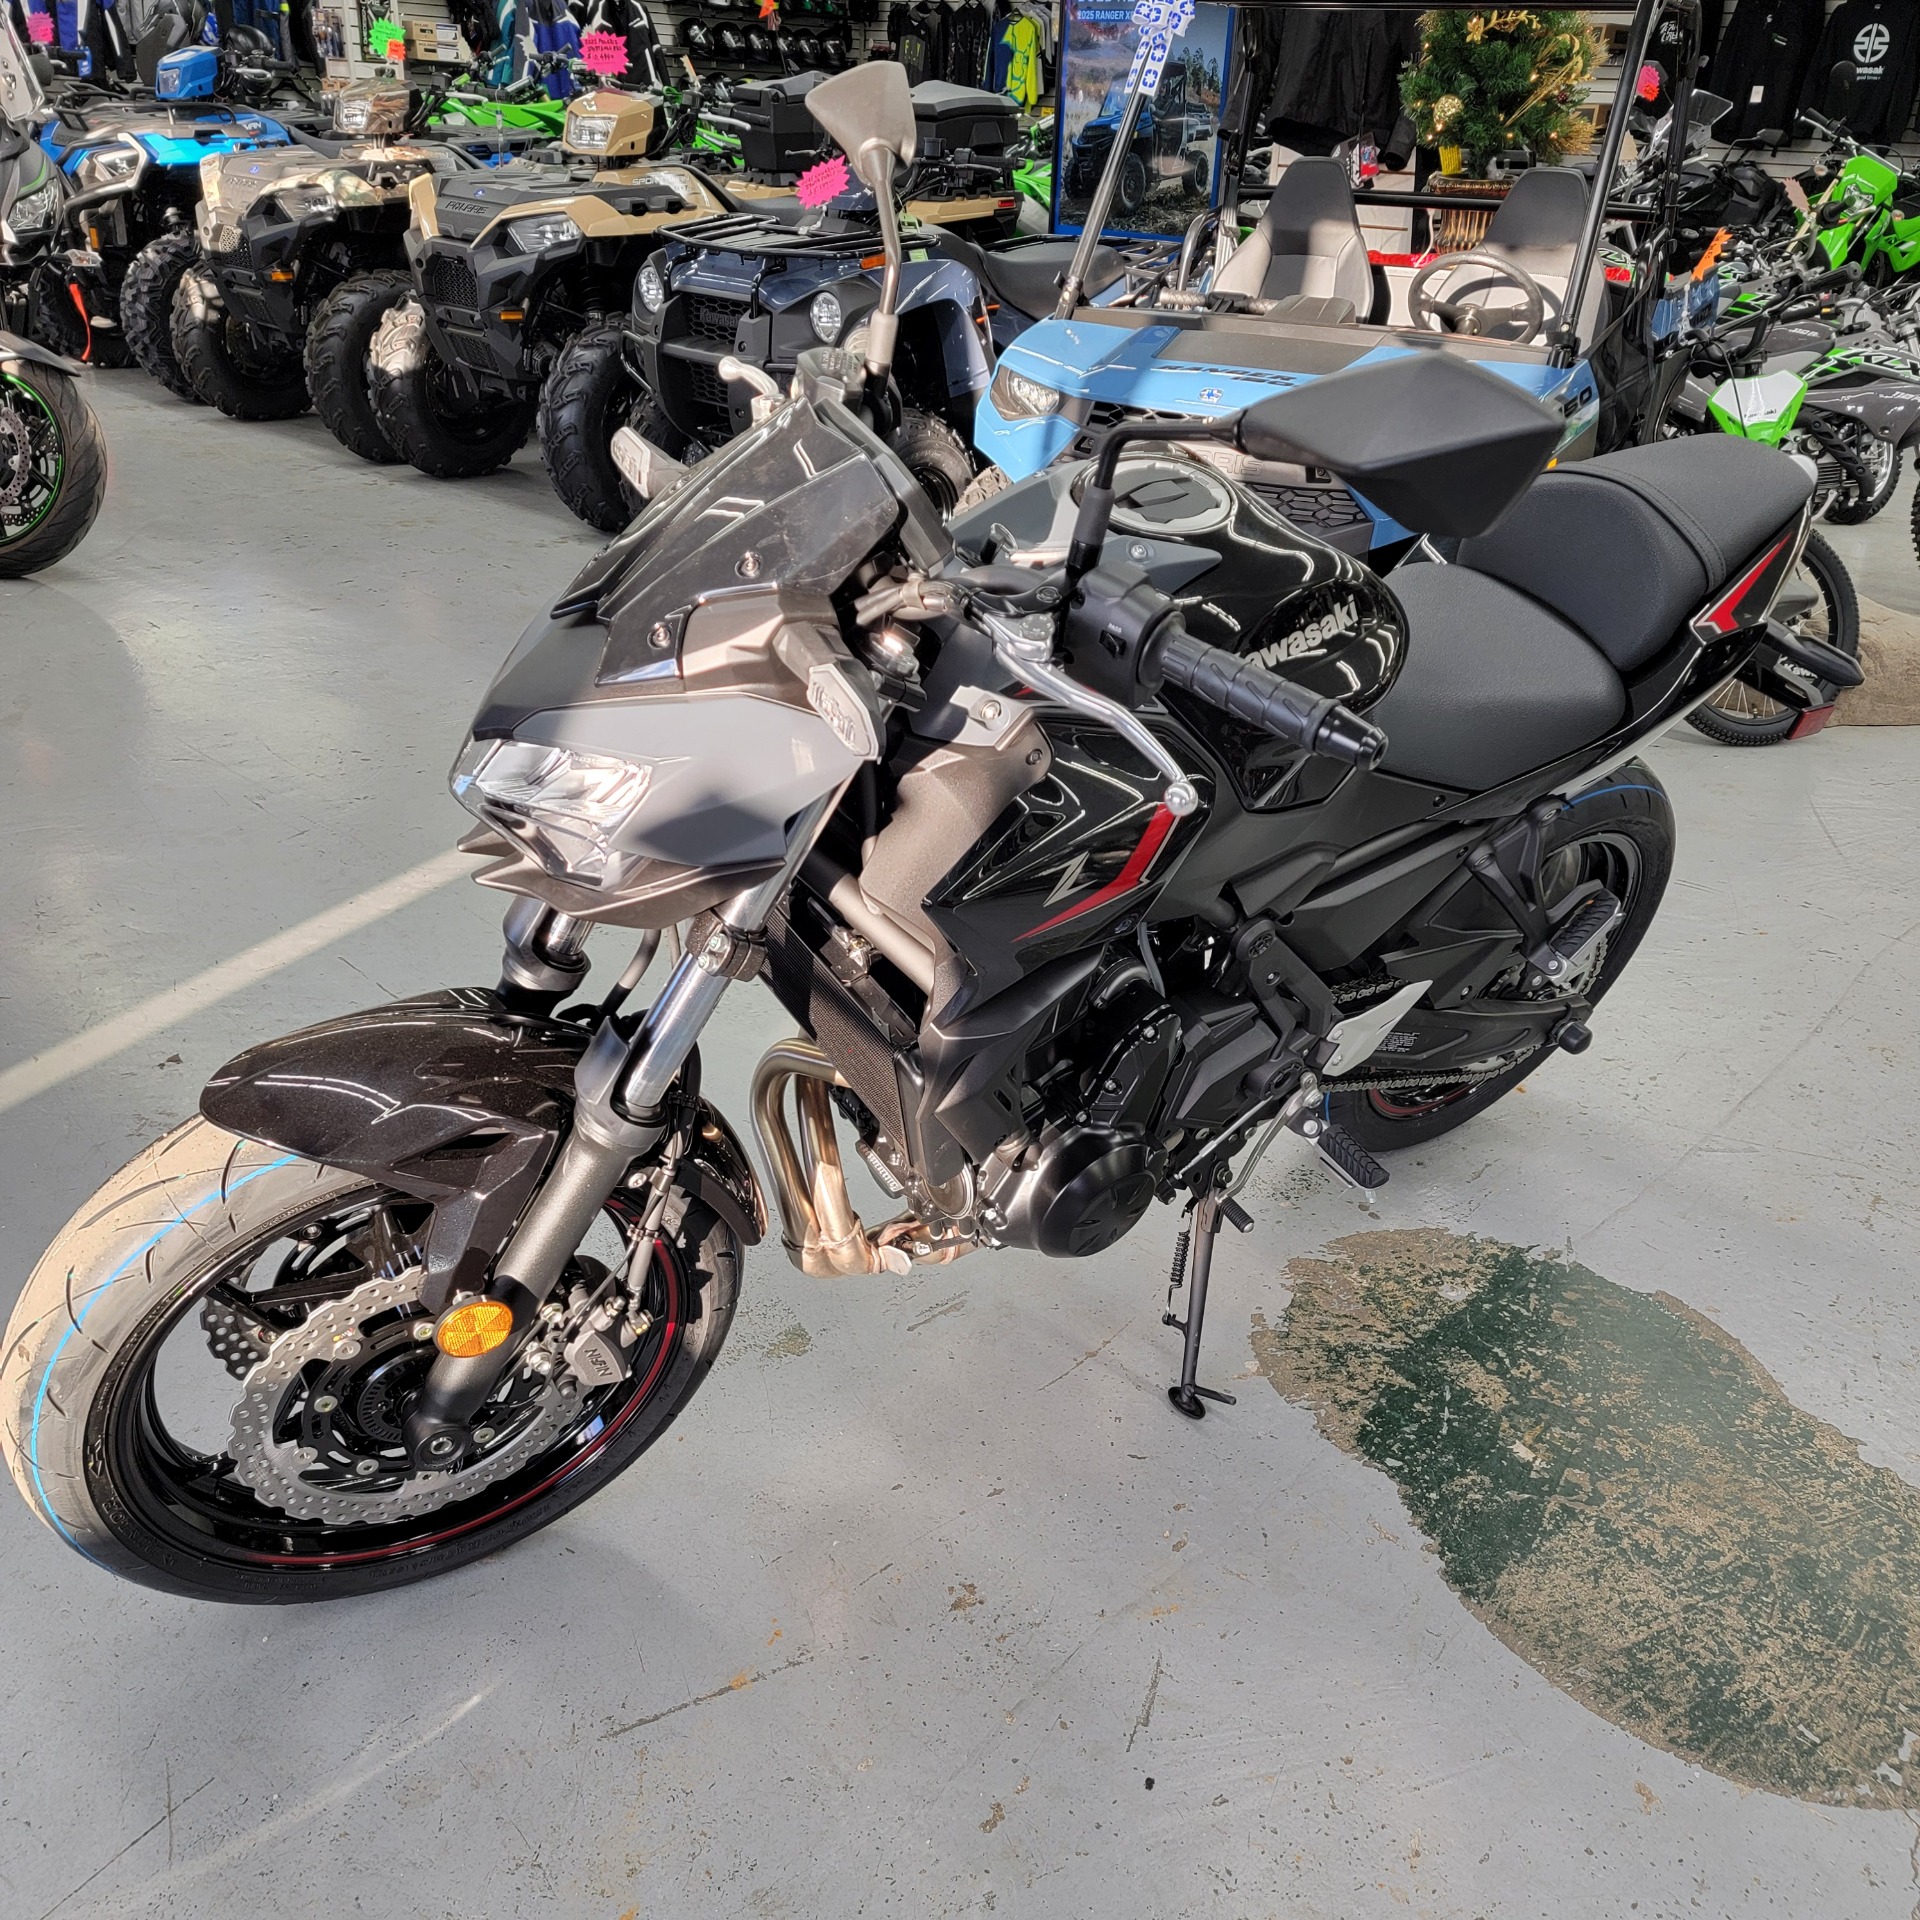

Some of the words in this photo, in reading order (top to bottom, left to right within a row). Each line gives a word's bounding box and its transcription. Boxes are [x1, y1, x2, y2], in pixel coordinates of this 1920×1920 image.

[1077, 10, 1095, 20] 2025
[1095, 10, 1125, 20] RANGER
[445, 201, 490, 214] POLARIS
[700, 307, 741, 328] Kawasak
[1158, 365, 1297, 381] RANGER
[1242, 594, 1359, 669] awasaki
[582, 1347, 613, 1377] NISSIN
